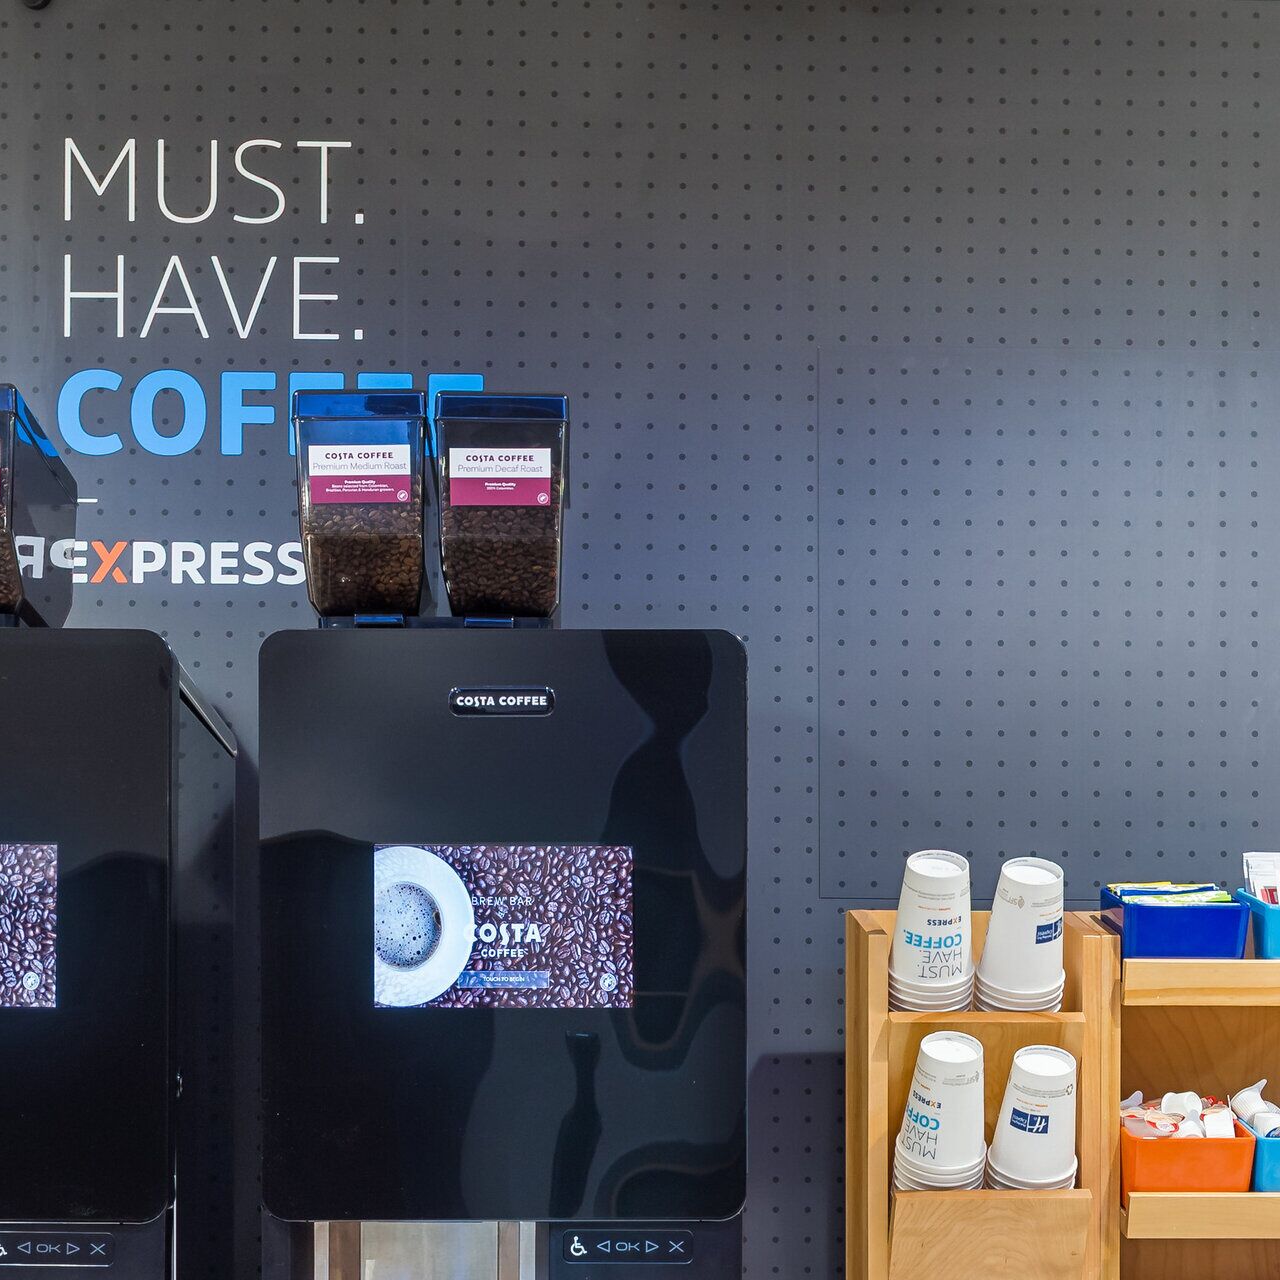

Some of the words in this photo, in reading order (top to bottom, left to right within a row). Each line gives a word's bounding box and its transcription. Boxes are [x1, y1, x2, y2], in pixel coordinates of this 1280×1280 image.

[64, 137, 365, 225] MUST.
[63, 254, 365, 341] HAVE.
[56, 368, 484, 457] COF
[325, 452, 354, 460] COSTA
[465, 455, 495, 463] COSTA
[312, 462, 349, 470] Premium
[350, 462, 382, 470] Medium
[384, 462, 407, 470] Roast
[457, 465, 494, 473] Premium
[495, 464, 518, 473] Decaf
[520, 464, 543, 473] Roast
[456, 695, 495, 708] COSTA
[499, 695, 547, 706] COFFEE
[471, 896, 505, 906] BREW
[509, 896, 533, 906] BAR
[926, 915, 962, 926] EXPRESS
[903, 929, 963, 949] COFFEE.
[481, 949, 525, 958] COFFEE
[919, 947, 963, 964] HAVE.
[917, 964, 963, 979] MUST.
[906, 1101, 940, 1131] COFF
[904, 1120, 938, 1145] HAVE
[901, 1135, 937, 1160] MUST
[36, 1243, 61, 1254] OK
[616, 1242, 640, 1252] OK
